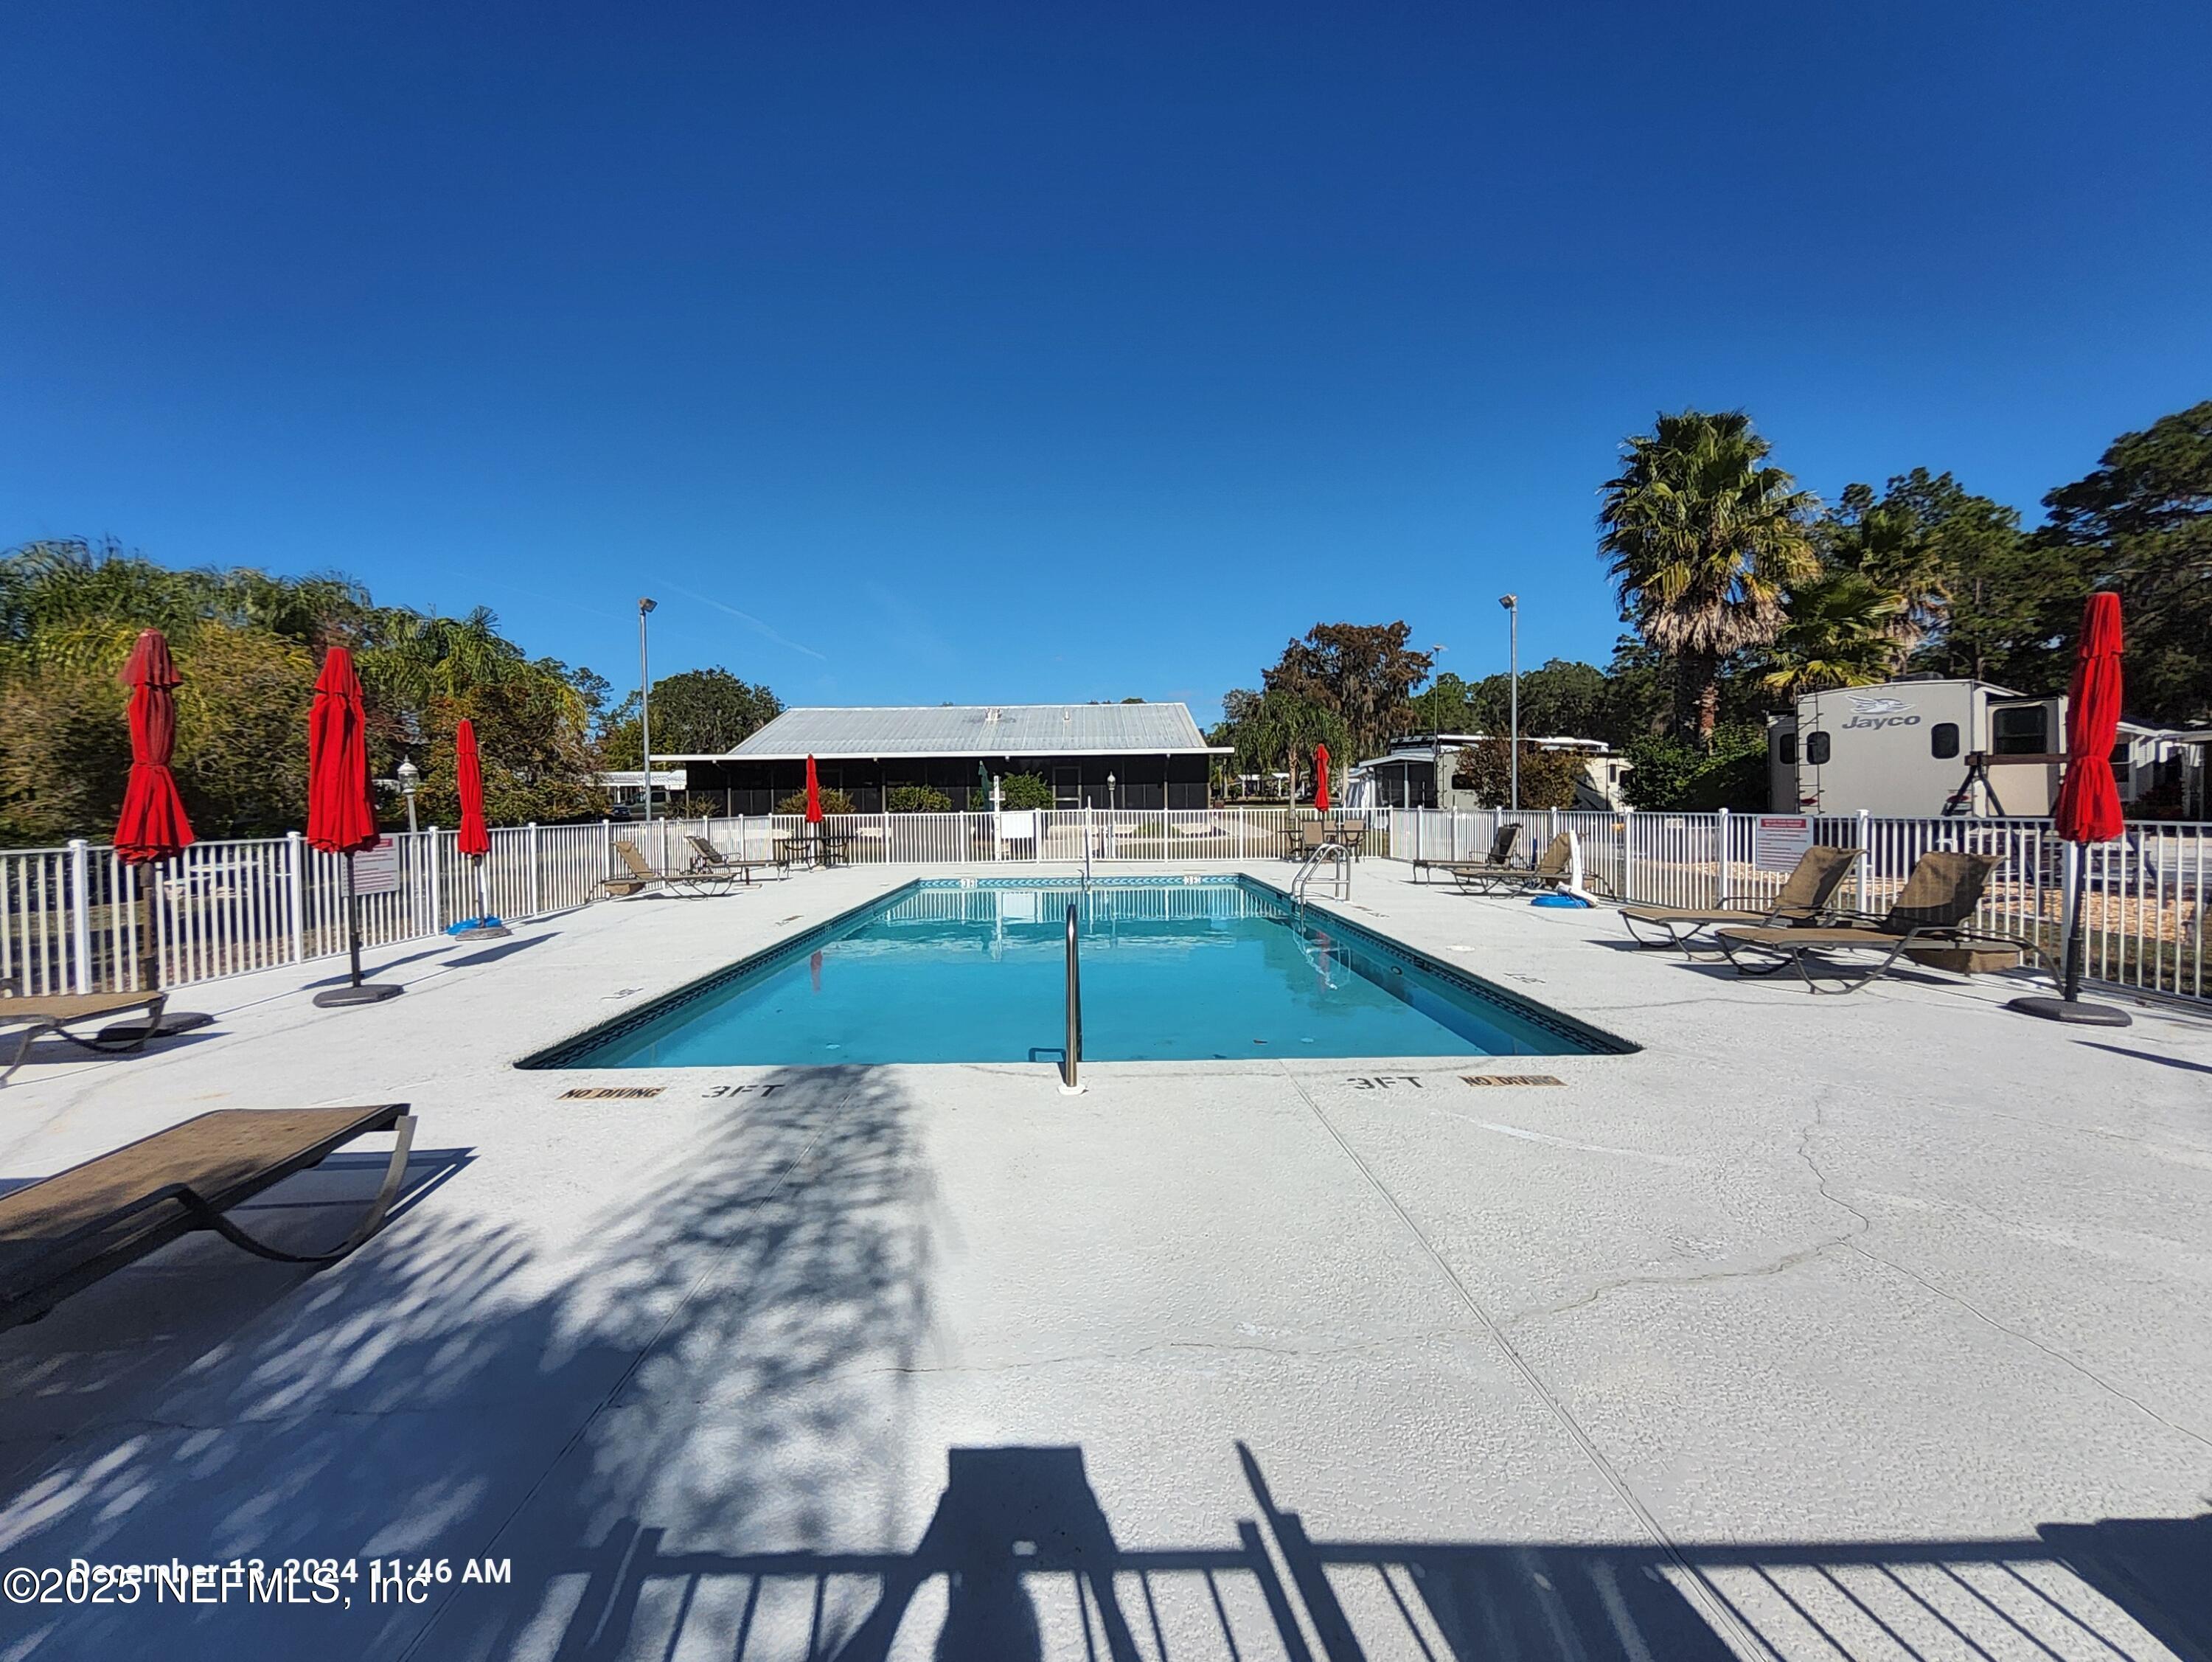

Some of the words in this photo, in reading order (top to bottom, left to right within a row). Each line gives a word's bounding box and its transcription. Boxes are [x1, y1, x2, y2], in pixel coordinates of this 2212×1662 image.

[1842, 715, 1921, 730] Jayco
[1346, 1077, 1424, 1089] 3FT
[1461, 1075, 1492, 1086] NO
[558, 1088, 592, 1099] NO
[595, 1088, 661, 1099] DIVING
[701, 1084, 785, 1098] 3FT
